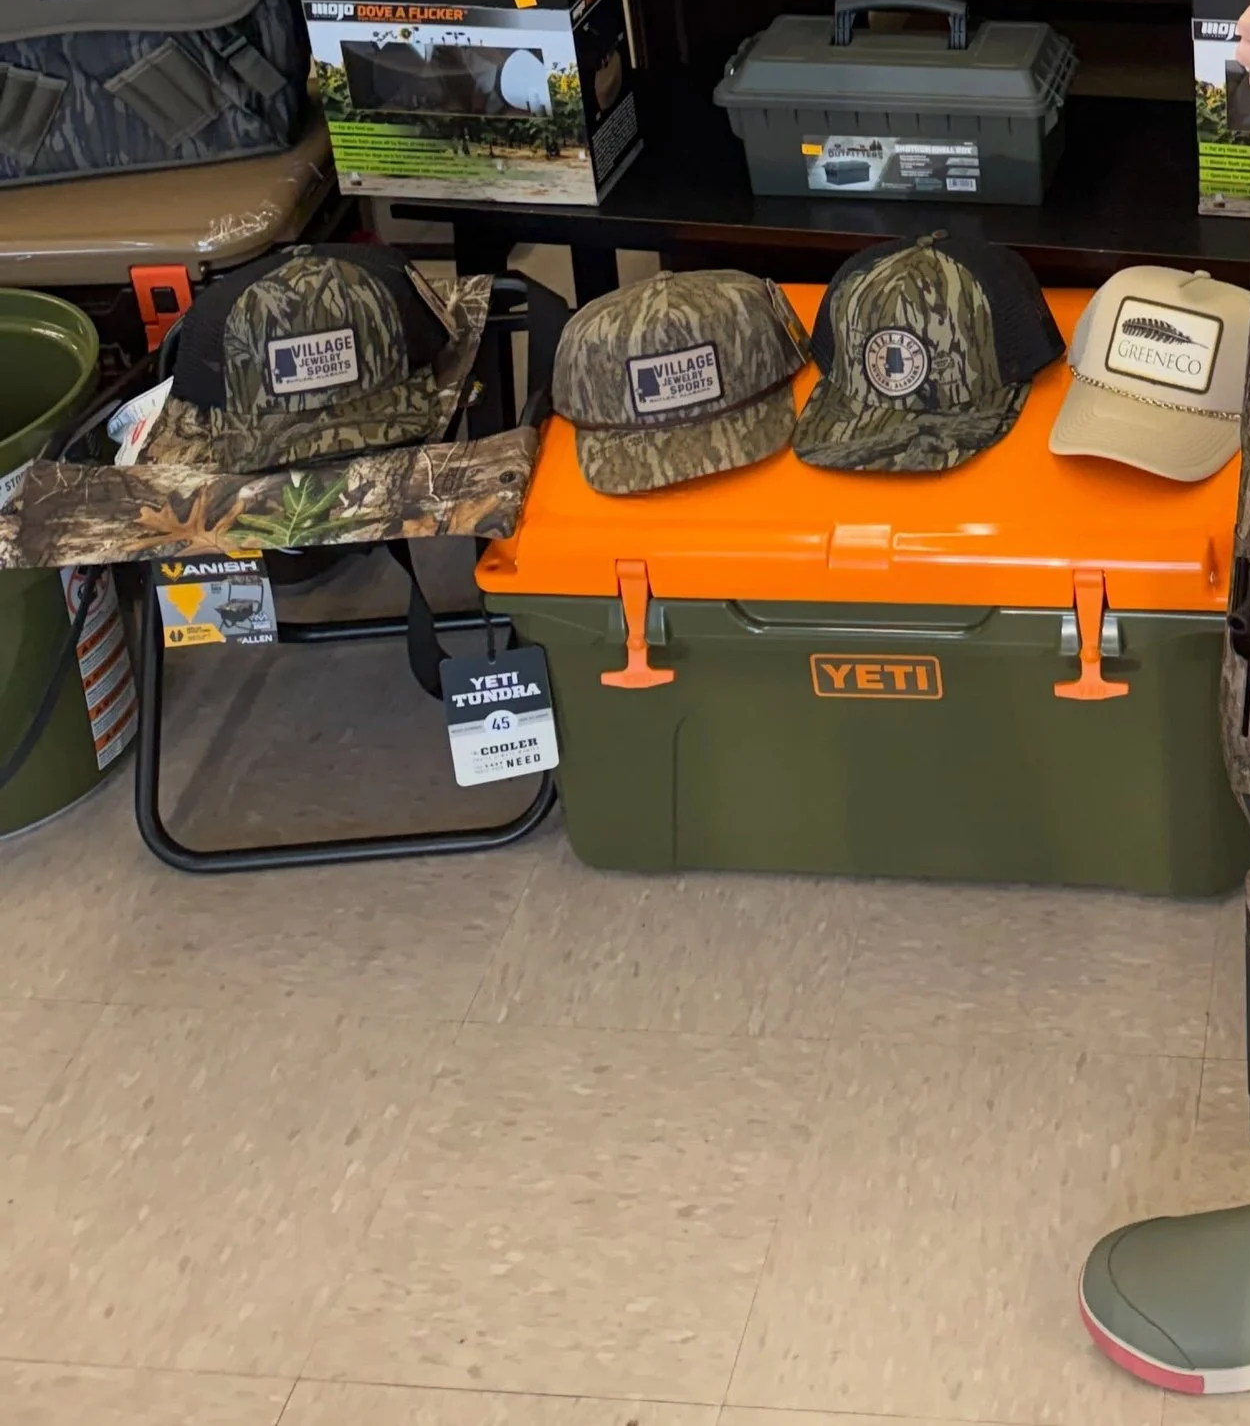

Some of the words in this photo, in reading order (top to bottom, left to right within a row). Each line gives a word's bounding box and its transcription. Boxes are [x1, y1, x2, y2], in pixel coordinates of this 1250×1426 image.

[311, 2, 355, 21] mojo
[357, 5, 393, 18] DOVE
[395, 6, 406, 18] A
[408, 6, 464, 21] FLICKER
[1201, 21, 1241, 41] moj
[828, 148, 884, 159] OUTFITTERS
[291, 335, 353, 358] VILLAGE
[299, 352, 341, 368] JEWELRY
[307, 360, 351, 376] SPORTS
[653, 352, 714, 378] VILLAGE
[662, 369, 703, 386] JEWELRY
[669, 376, 714, 394] SPORTS
[161, 560, 258, 582] VANISH
[241, 634, 273, 645] ALLEN
[469, 671, 519, 691] YETI
[820, 664, 929, 691] YETI
[451, 682, 542, 708] TUNDRA
[491, 716, 510, 731] 45
[480, 737, 539, 757] COOLER
[506, 753, 541, 768] NEED
